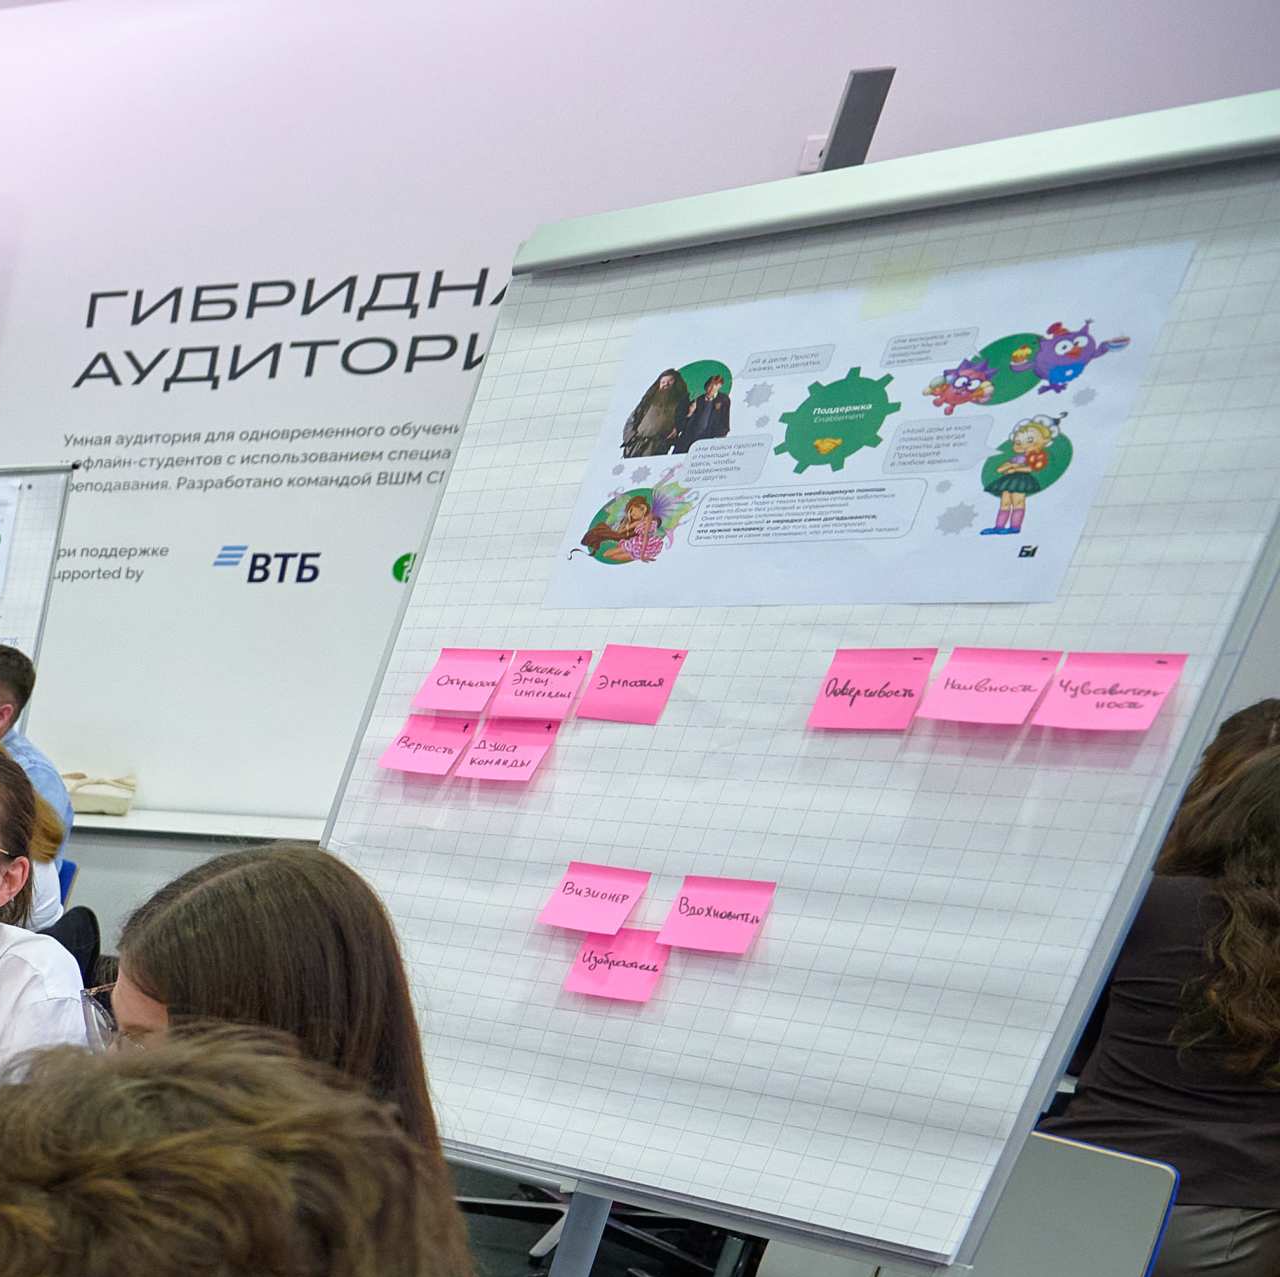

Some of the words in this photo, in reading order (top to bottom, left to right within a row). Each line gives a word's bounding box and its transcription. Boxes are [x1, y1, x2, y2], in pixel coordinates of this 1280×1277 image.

[812, 402, 873, 416] Поддержка
[813, 413, 865, 424] Enablement
[63, 432, 111, 448] Умная
[115, 429, 201, 448] аудитория
[204, 430, 235, 445] для
[238, 424, 384, 442] одновременного
[226, 454, 236, 464] с
[239, 450, 383, 466] использованием
[176, 475, 283, 492] Разработано
[286, 471, 372, 488] командой
[376, 470, 422, 486] ВШМ
[80, 545, 169, 560] поддержке
[125, 566, 144, 582] by
[247, 551, 321, 584] ВТБ
[597, 675, 665, 690] Эмпатия
[397, 735, 454, 755] Верность
[474, 739, 518, 754] Душа
[469, 756, 532, 769] команды
[562, 881, 630, 905] Визионер
[678, 896, 760, 925] Вдохновитель
